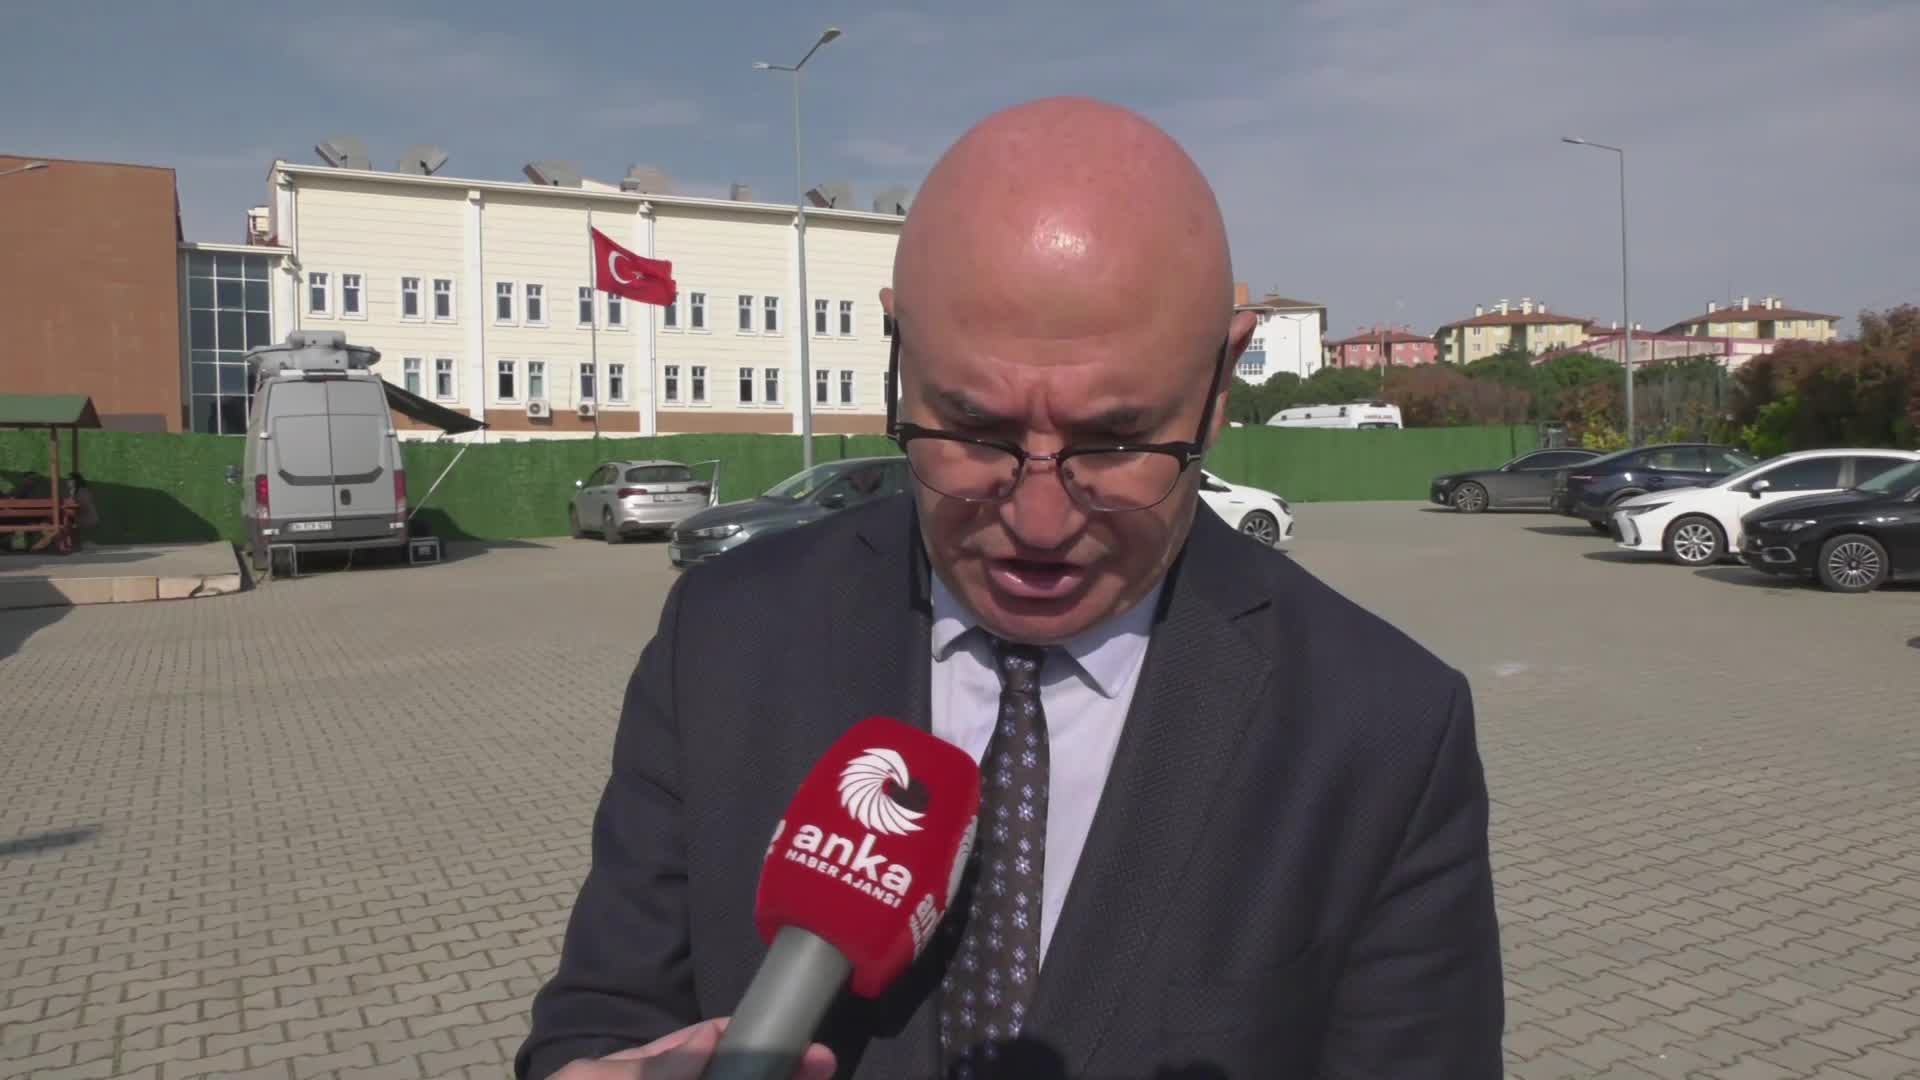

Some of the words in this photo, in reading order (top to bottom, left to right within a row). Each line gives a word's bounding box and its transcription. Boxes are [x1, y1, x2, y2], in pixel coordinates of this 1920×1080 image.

[785, 849, 840, 878] HABER
[841, 873, 902, 908] AJANSI
[792, 824, 912, 896] anka
